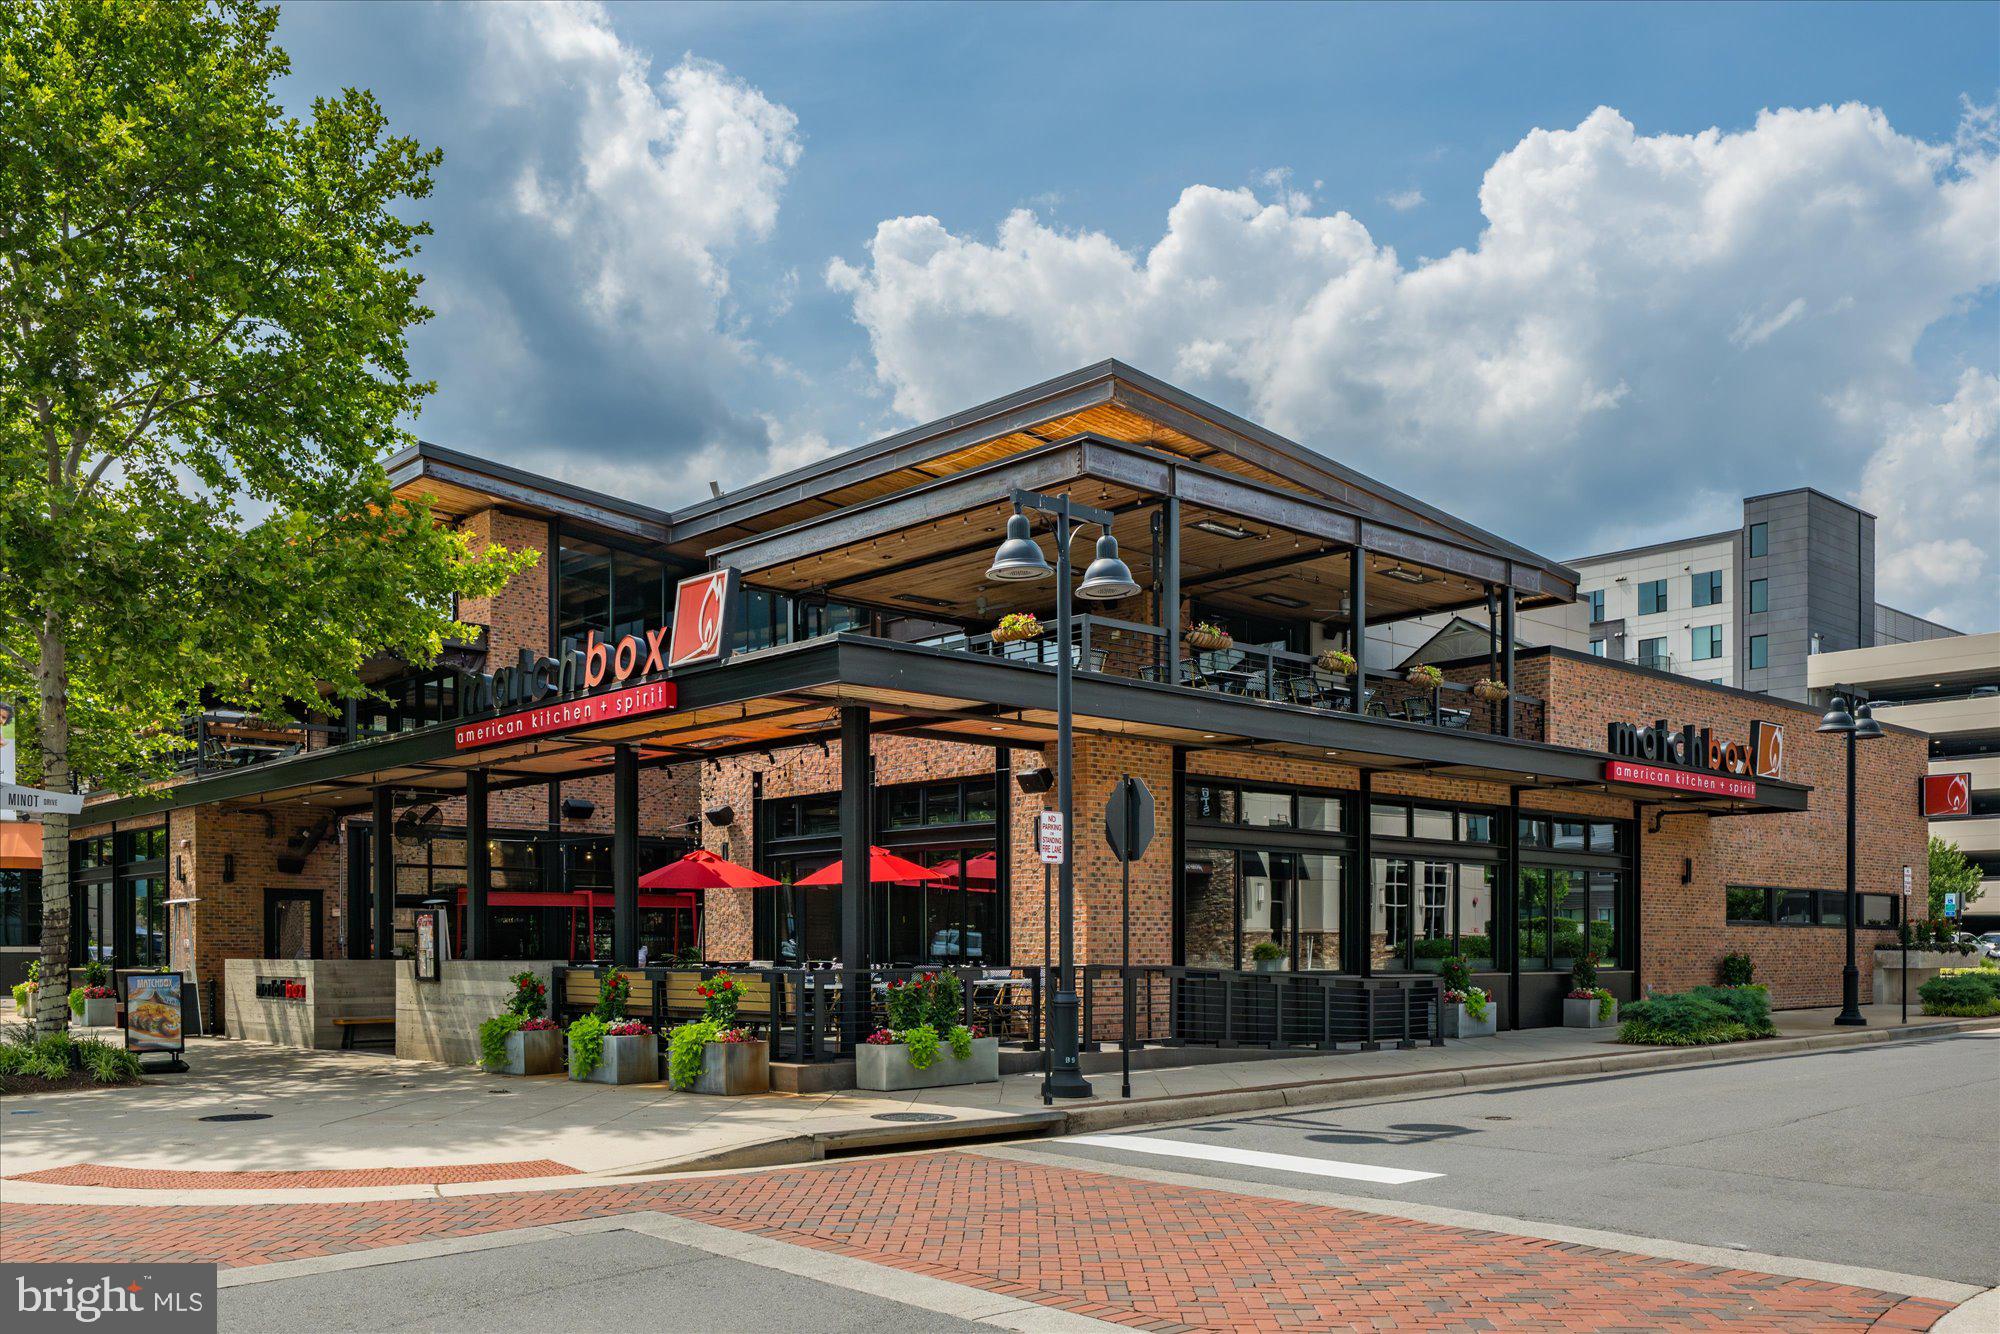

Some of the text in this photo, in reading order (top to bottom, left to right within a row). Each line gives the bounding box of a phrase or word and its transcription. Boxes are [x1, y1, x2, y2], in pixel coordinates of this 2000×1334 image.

[459, 626, 668, 717] matchbox
[457, 686, 664, 744] american kitchen + spirit
[1608, 719, 1754, 777] matchbox
[1616, 765, 1670, 783] american
[1675, 773, 1716, 789] kitchen
[1729, 781, 1756, 795] spirit
[8, 793, 40, 808] MINOT
[1042, 823, 1062, 831] PARKING
[1042, 845, 1062, 853] FIRE LANE
[136, 978, 173, 988] MATCHBOX
